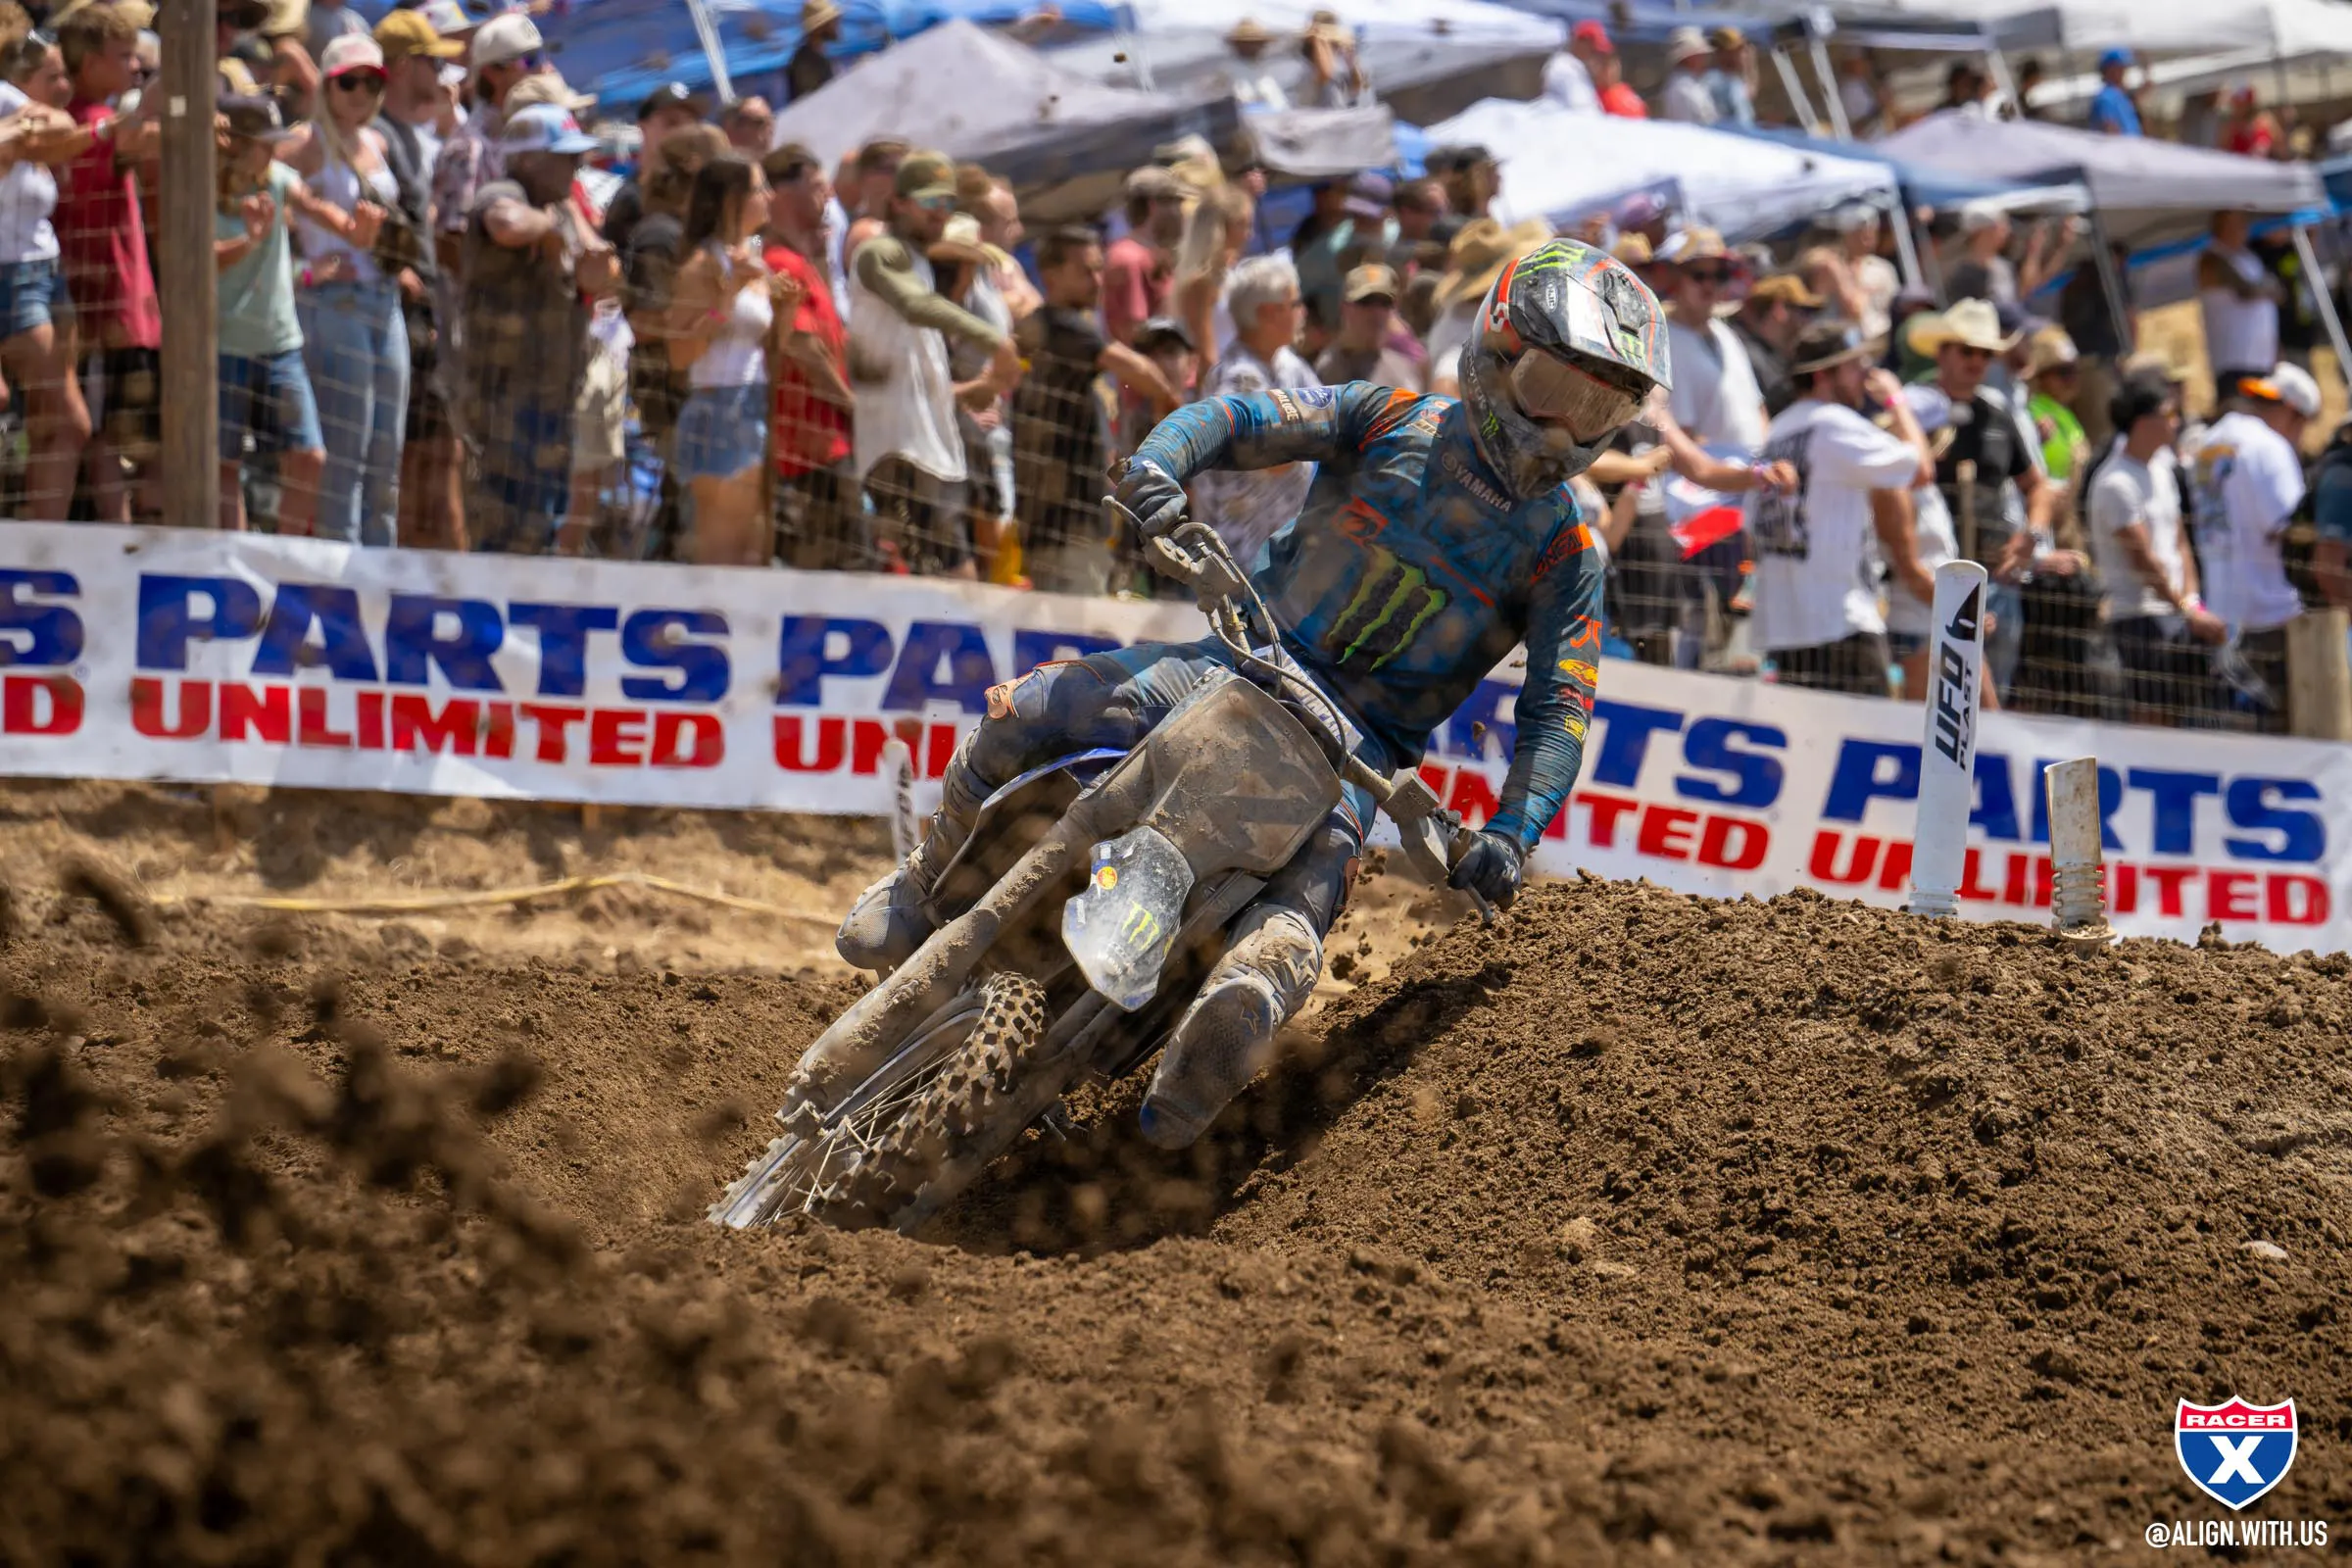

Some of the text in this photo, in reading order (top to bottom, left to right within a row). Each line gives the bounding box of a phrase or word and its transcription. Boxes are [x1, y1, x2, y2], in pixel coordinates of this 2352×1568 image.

[1454, 465, 1512, 513] YAMAHA
[136, 574, 730, 704] PARTS
[131, 677, 726, 769] UNLIMITED
[1936, 641, 1964, 763] UFO
[1959, 660, 1973, 772] PLAST
[1809, 831, 2331, 927] ULIITED
